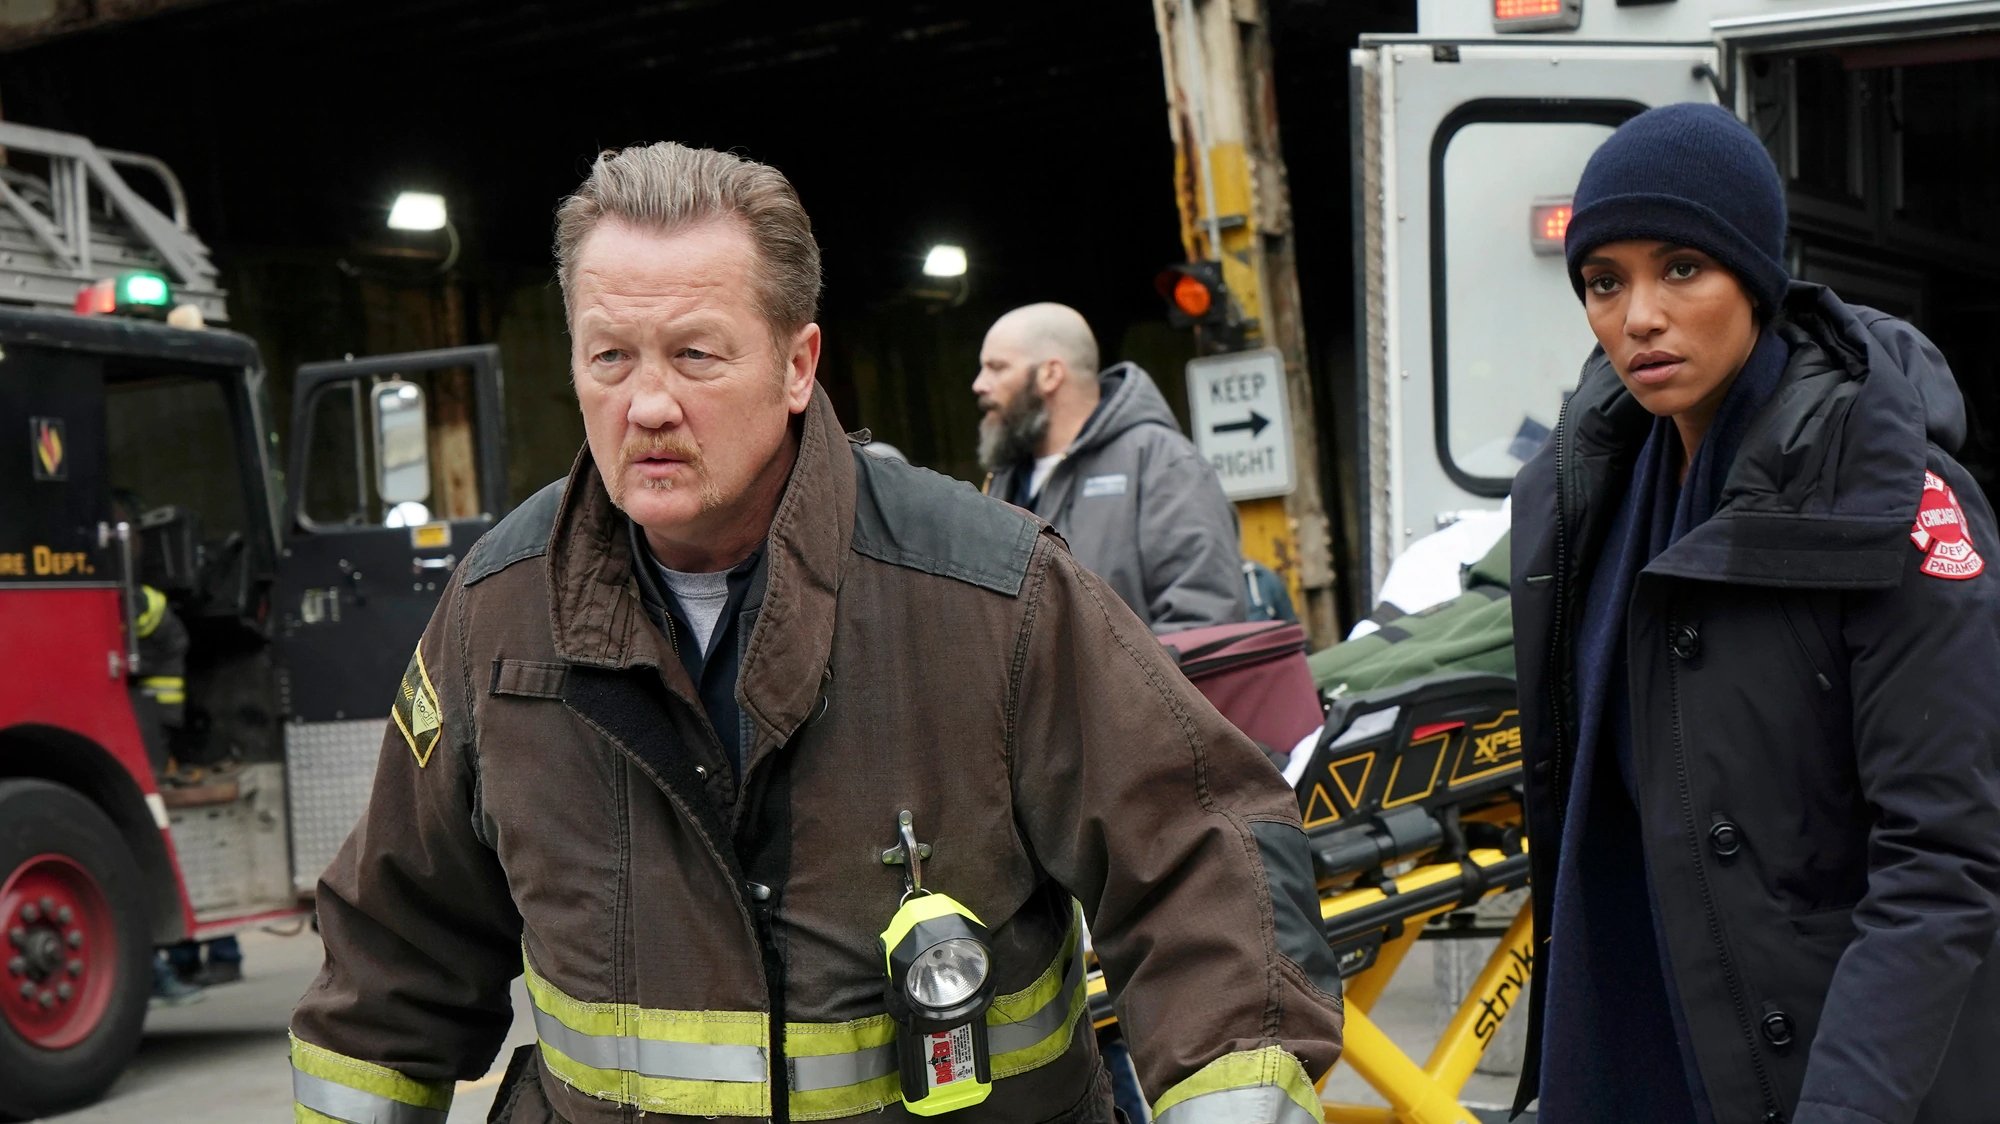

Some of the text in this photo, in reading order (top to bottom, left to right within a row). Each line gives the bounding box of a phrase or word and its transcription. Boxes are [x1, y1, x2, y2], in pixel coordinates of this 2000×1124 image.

[1210, 373, 1266, 405] KEEP
[1211, 447, 1275, 476] RIGHT
[1920, 508, 1958, 527] CHICAGO
[1940, 543, 1968, 556] DEPT
[1474, 727, 1521, 762] XPS
